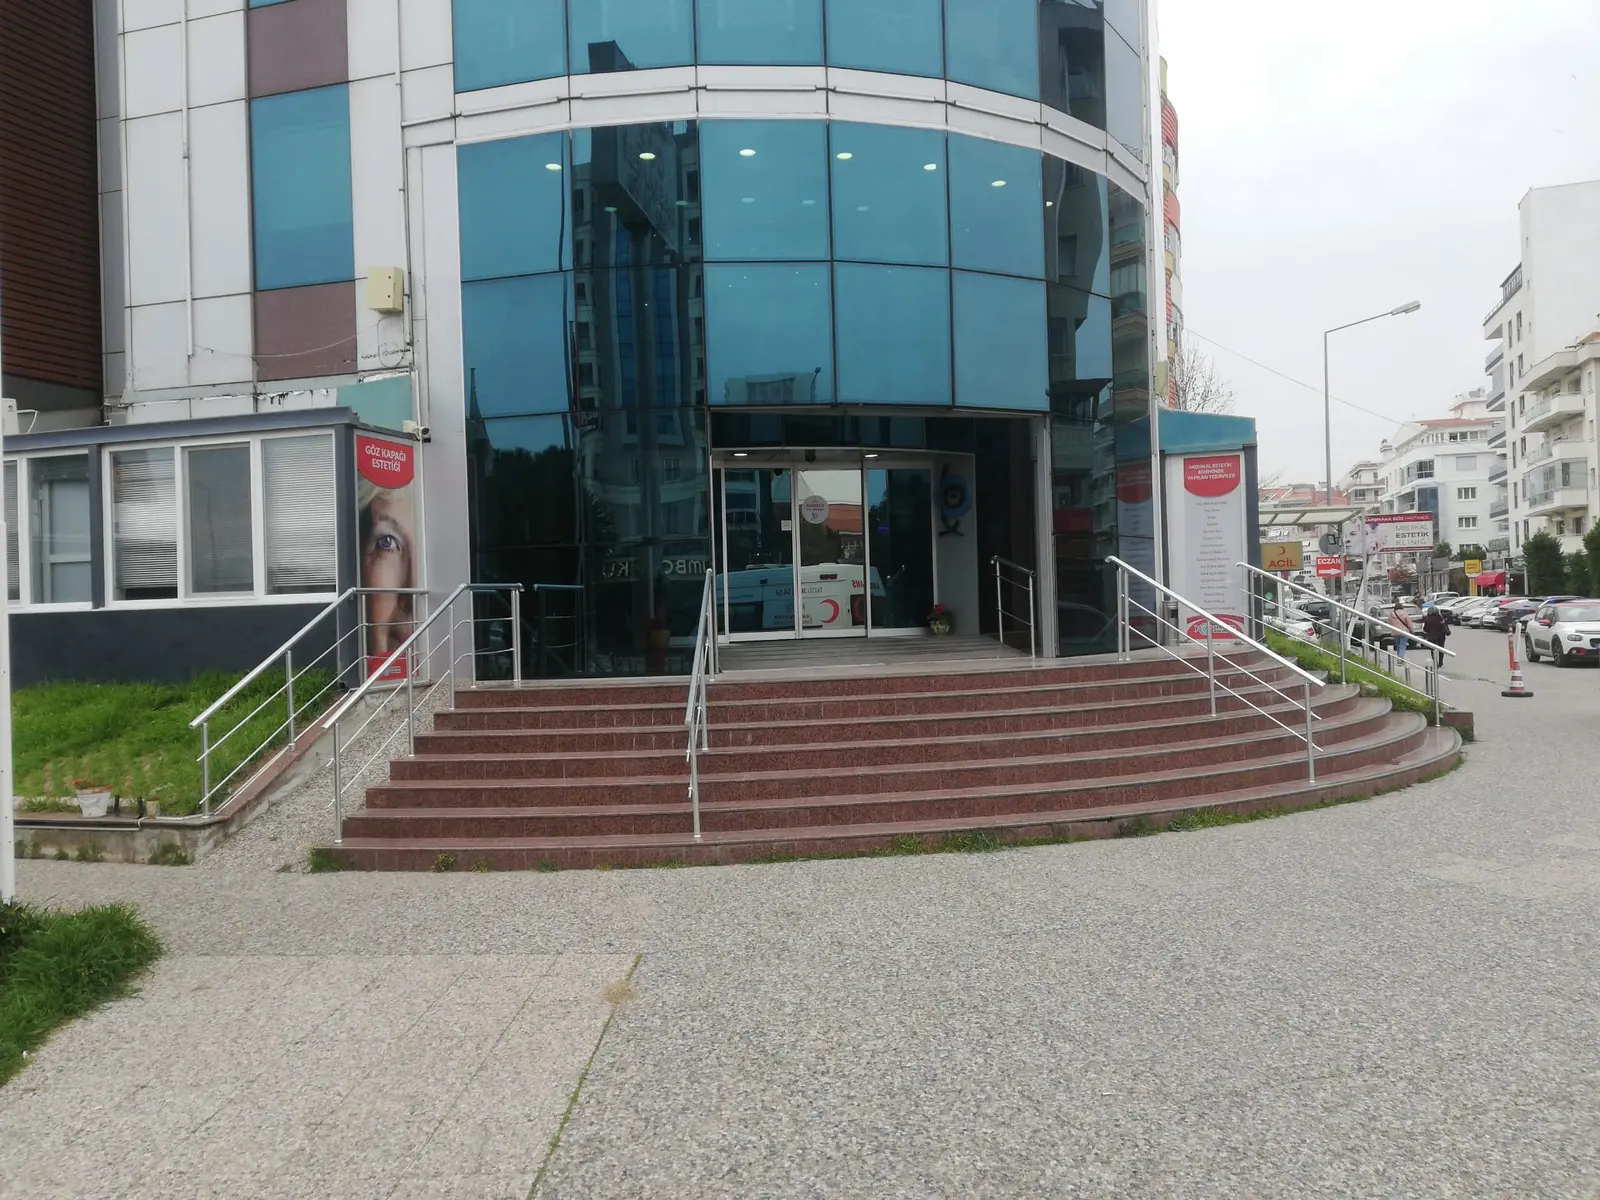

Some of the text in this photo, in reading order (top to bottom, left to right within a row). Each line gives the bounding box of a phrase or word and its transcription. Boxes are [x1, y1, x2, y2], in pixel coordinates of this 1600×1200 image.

[365, 444, 407, 462] GÖZ KAPAĞI
[372, 458, 401, 472] ESTETİĞİ
[1395, 531, 1429, 539] ESTETİK
[1268, 557, 1296, 568] ACİL
